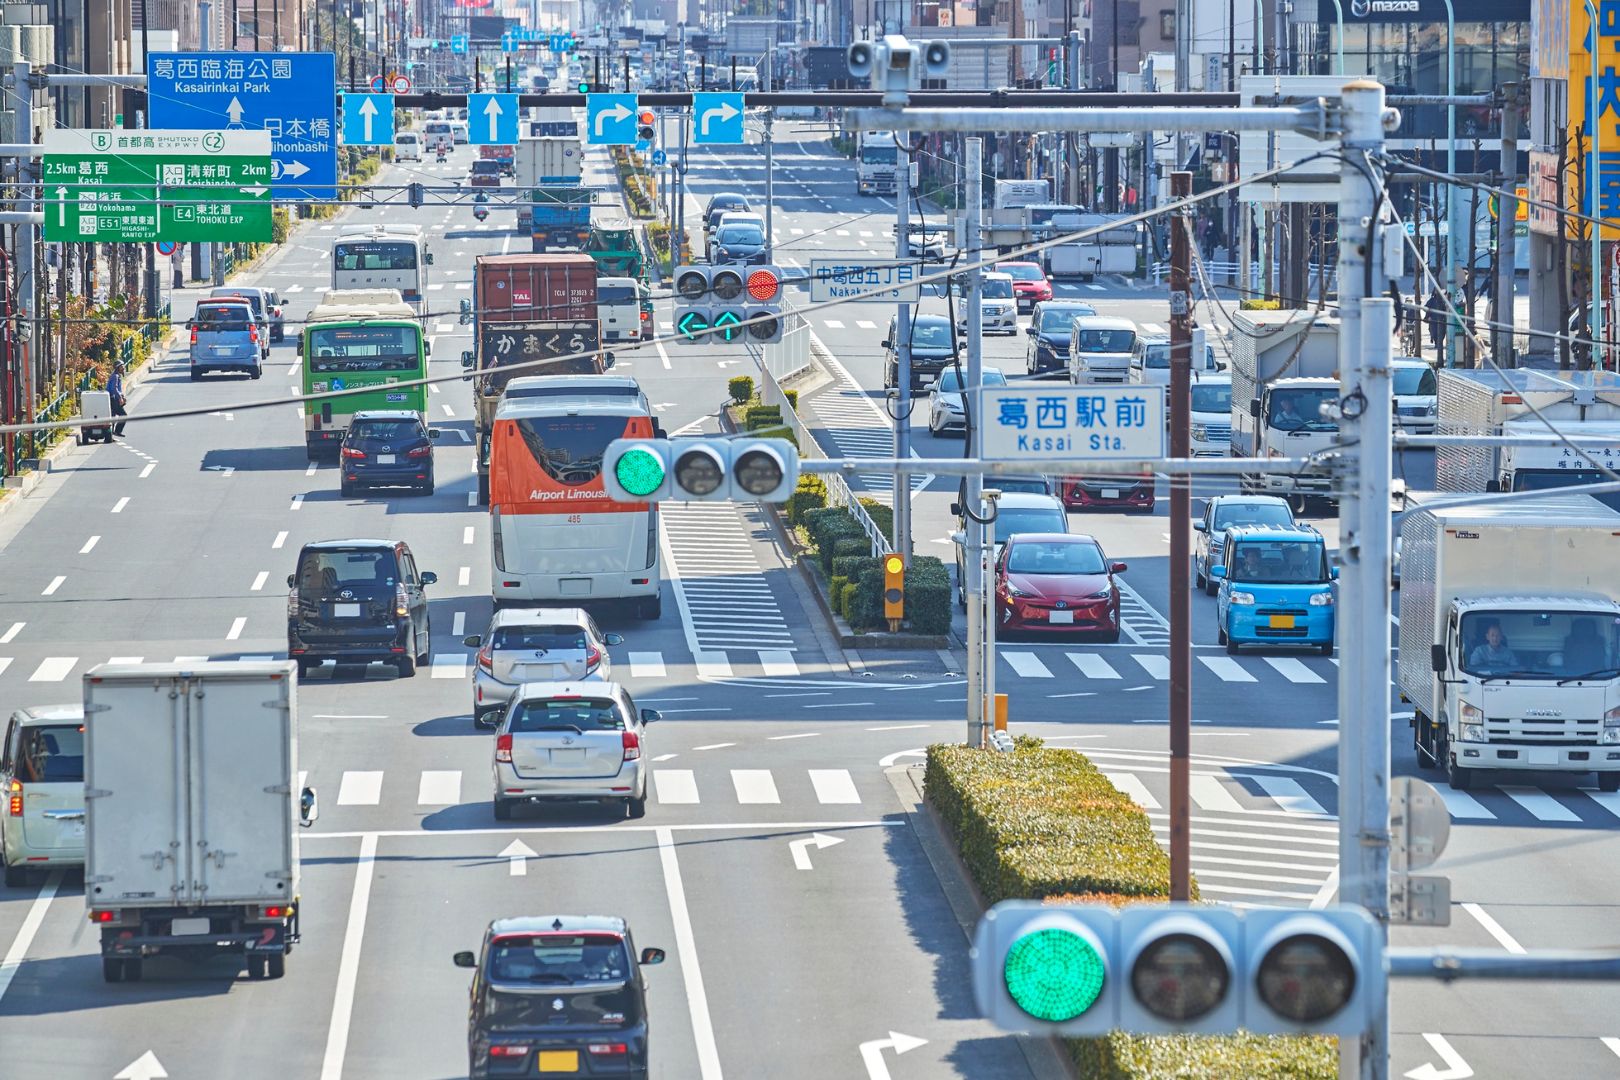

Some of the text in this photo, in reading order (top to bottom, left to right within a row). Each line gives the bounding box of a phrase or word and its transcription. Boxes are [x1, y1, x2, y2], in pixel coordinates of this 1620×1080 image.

[154, 58, 292, 79] 葛西臨海公園
[175, 82, 271, 93] Kasairinkai Park
[264, 118, 331, 139] 日本橋
[98, 135, 106, 147] B
[118, 136, 155, 148] 首都高
[205, 136, 221, 148] C2
[271, 141, 328, 153] ihonbashi
[46, 163, 77, 175] 2.5km
[78, 161, 108, 175] 葛西
[165, 167, 183, 175] 入口
[187, 164, 231, 177] 清新町
[242, 164, 267, 175] 2km
[98, 204, 136, 212] Yokohama
[177, 208, 192, 219] E4
[196, 204, 231, 215] 東北道
[100, 219, 119, 228] E51
[196, 216, 244, 224] TOHOKU EXP
[816, 266, 913, 285] 中葛西五丁目
[497, 333, 586, 354] かまくら
[997, 396, 1147, 429] 葛西駅前
[1018, 434, 1126, 451] Kasai Sta.
[530, 489, 565, 500] Airport
